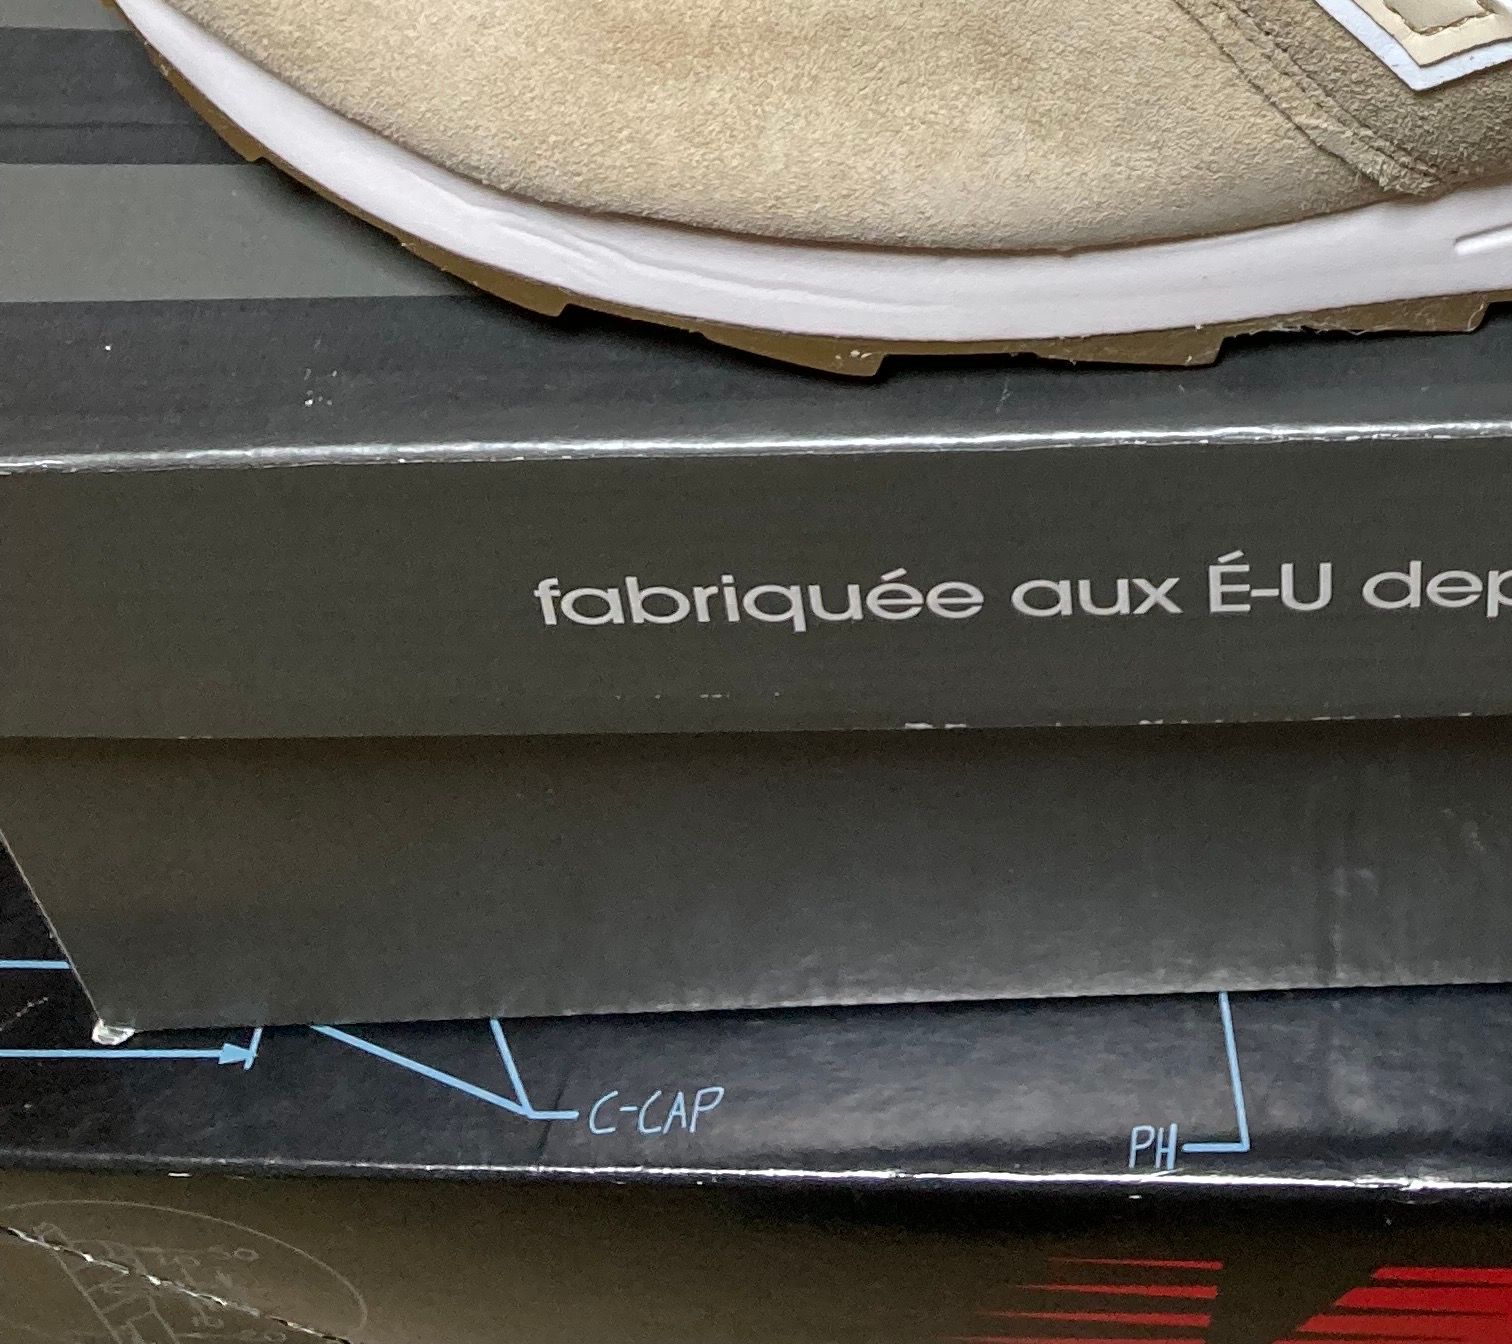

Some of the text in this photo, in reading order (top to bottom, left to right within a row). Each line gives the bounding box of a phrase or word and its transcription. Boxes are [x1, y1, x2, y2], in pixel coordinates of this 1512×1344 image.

[533, 567, 984, 633] fabriquée
[1011, 577, 1183, 617] aux
[1208, 549, 1332, 613] É-U
[588, 1085, 725, 1135] C-CAP
[1128, 1123, 1178, 1170] PH
